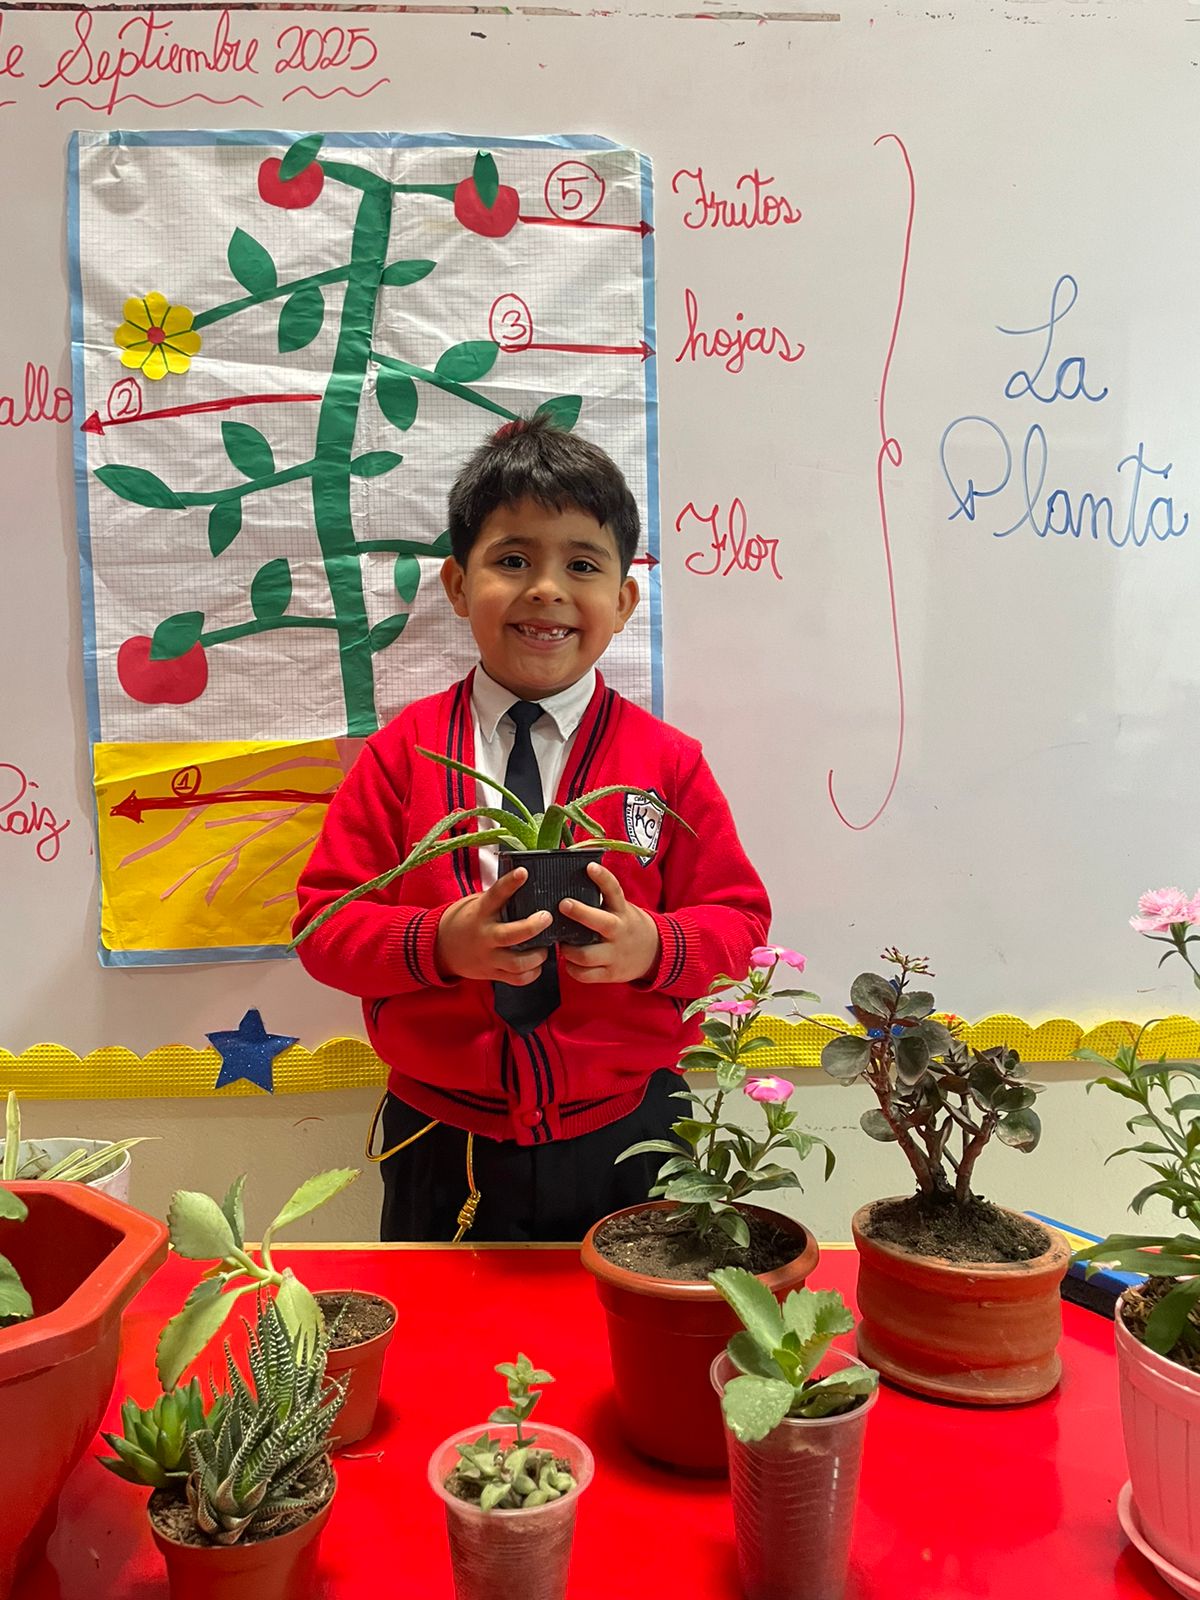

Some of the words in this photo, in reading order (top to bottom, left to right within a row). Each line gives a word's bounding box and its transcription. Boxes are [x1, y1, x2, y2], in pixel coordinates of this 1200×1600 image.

[0, 12, 25, 78] e
[38, 10, 259, 115] Septiembre
[274, 26, 378, 71] 2025
[672, 167, 802, 229] Frutos
[675, 288, 805, 374] hojas
[995, 275, 1108, 403] La
[0, 361, 73, 426] allo
[940, 415, 1189, 547] Planta
[675, 498, 783, 580] Flor
